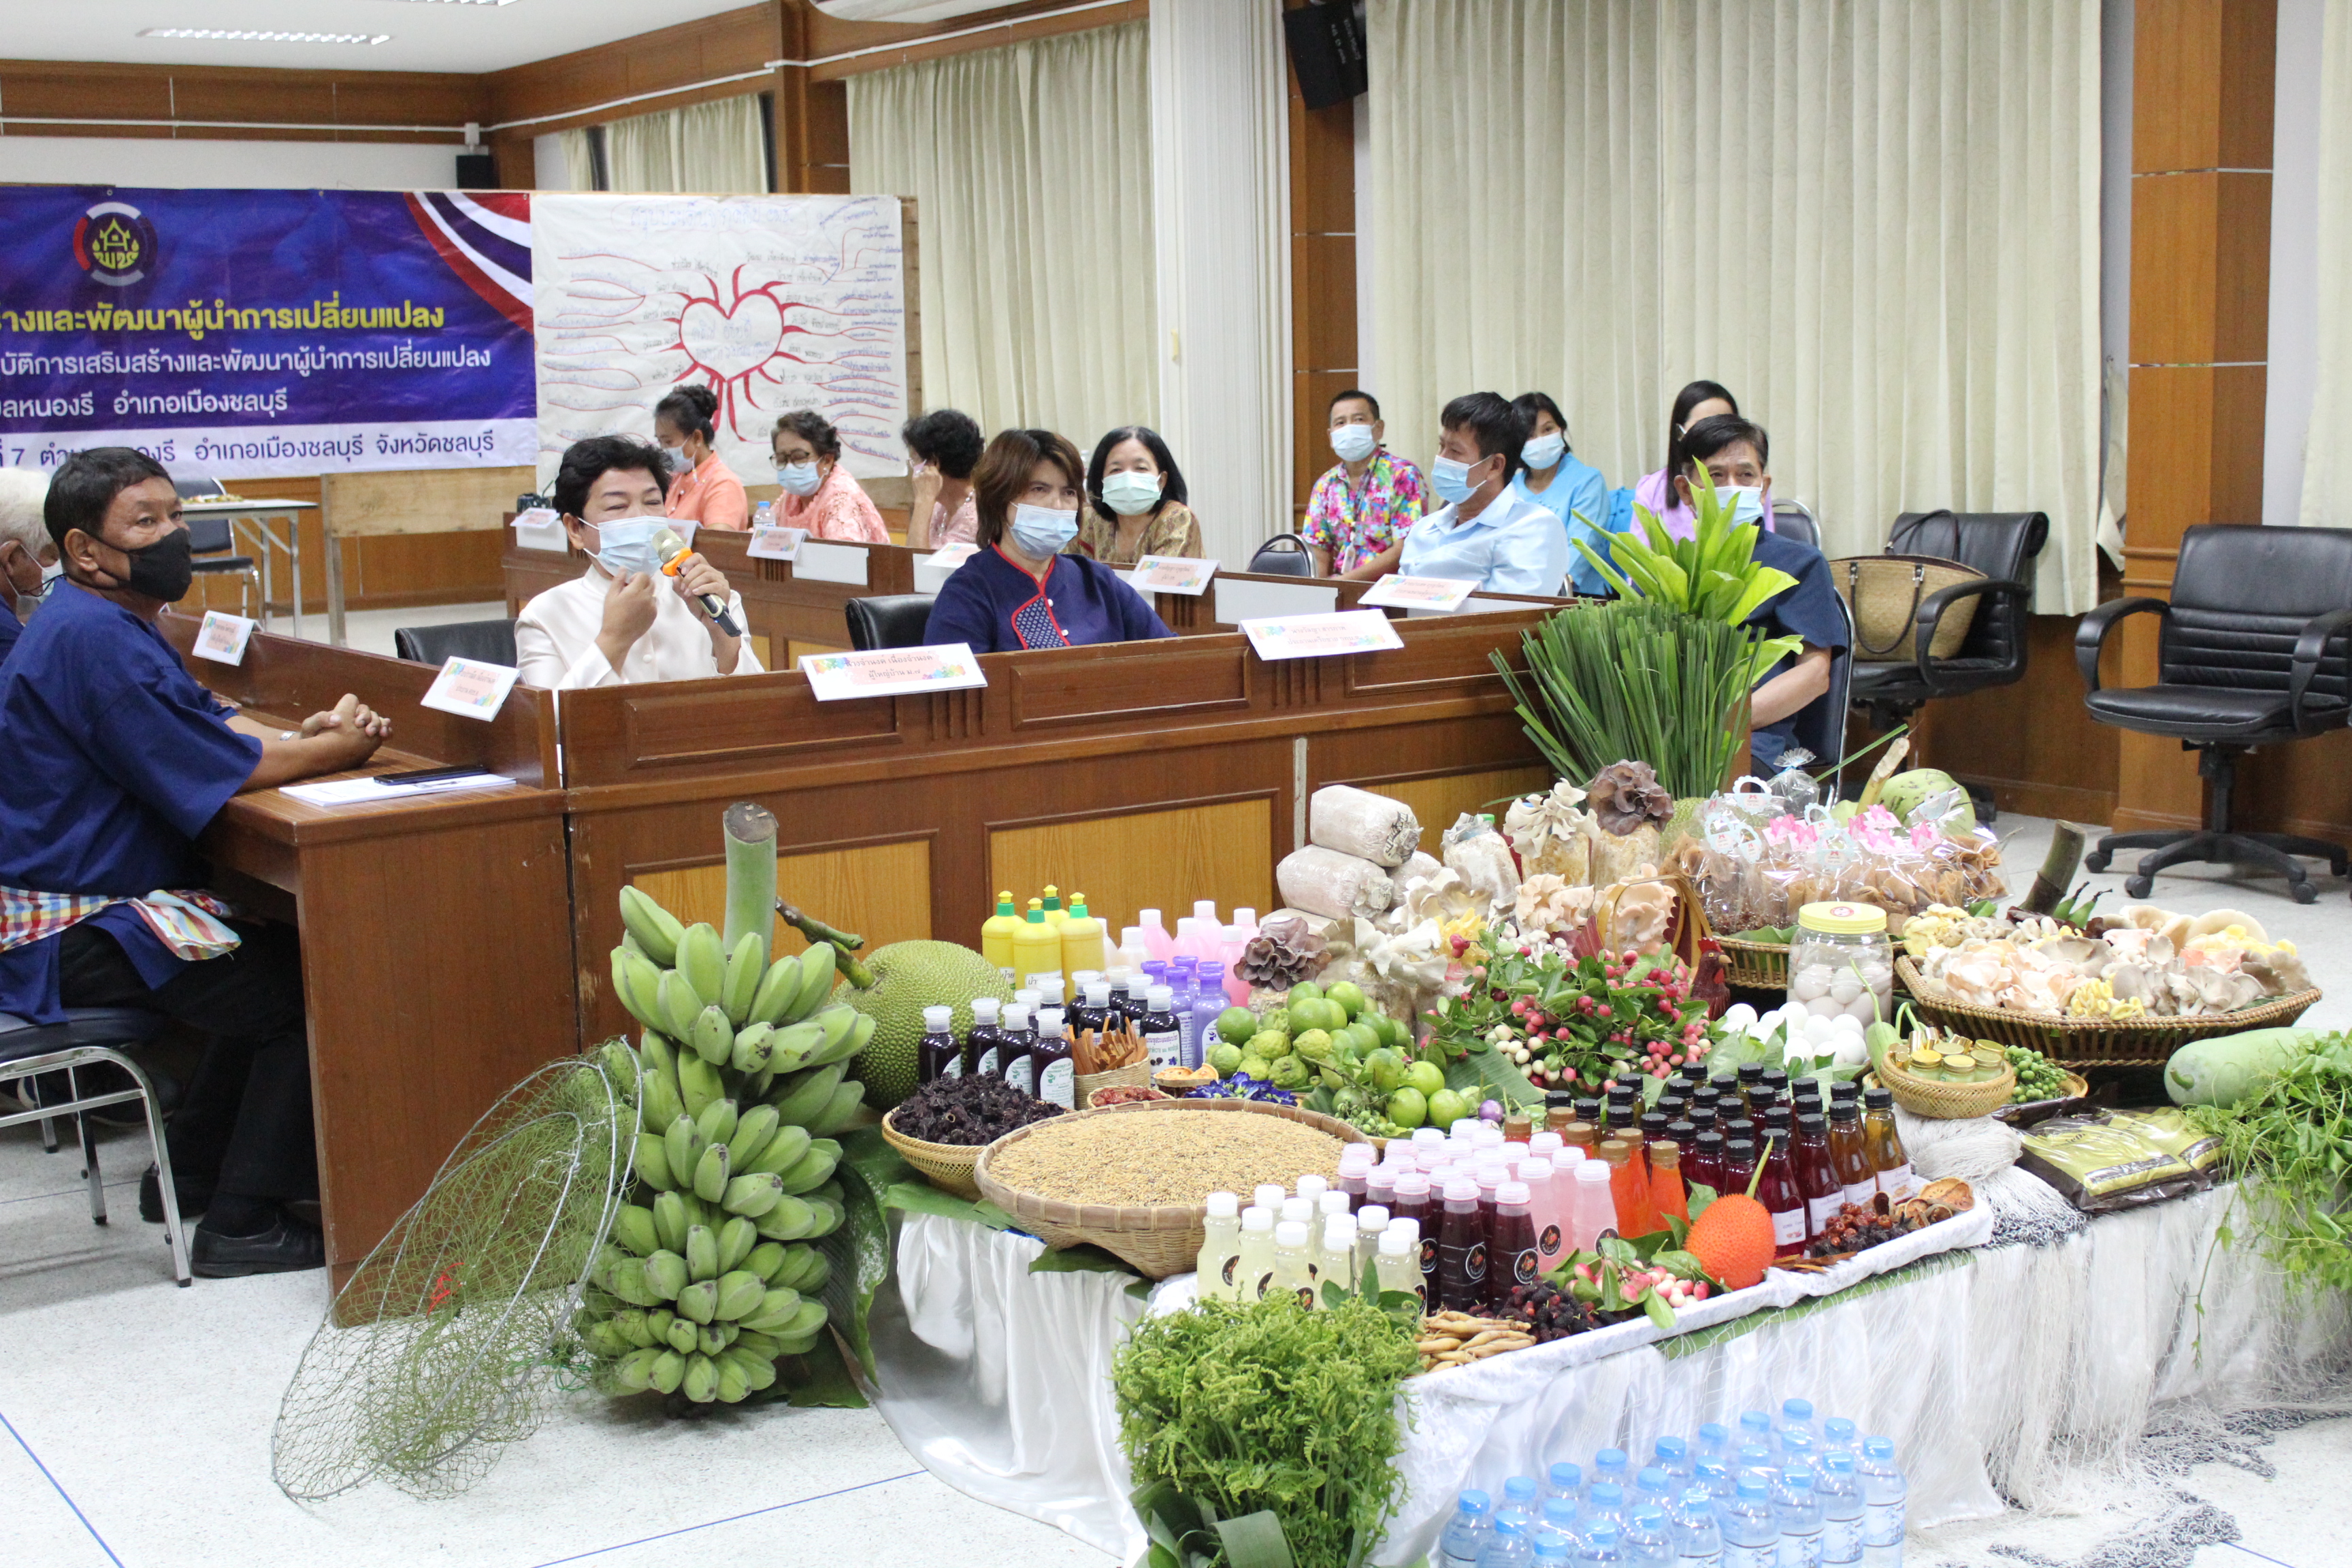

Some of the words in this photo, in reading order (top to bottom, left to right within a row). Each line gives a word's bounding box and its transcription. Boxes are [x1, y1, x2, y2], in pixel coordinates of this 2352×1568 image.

[0, 291, 444, 340] างและพัฒนาผู้นำการเปลี่ยนแปลง
[0, 391, 94, 418] ลหนองรี
[114, 387, 288, 418] อำเภอเมืองชลบุรี
[12, 448, 25, 466] 7
[195, 434, 363, 463] อำเภอเมืองชลบุรี
[376, 430, 494, 458] จังหวัดชลบุรี
